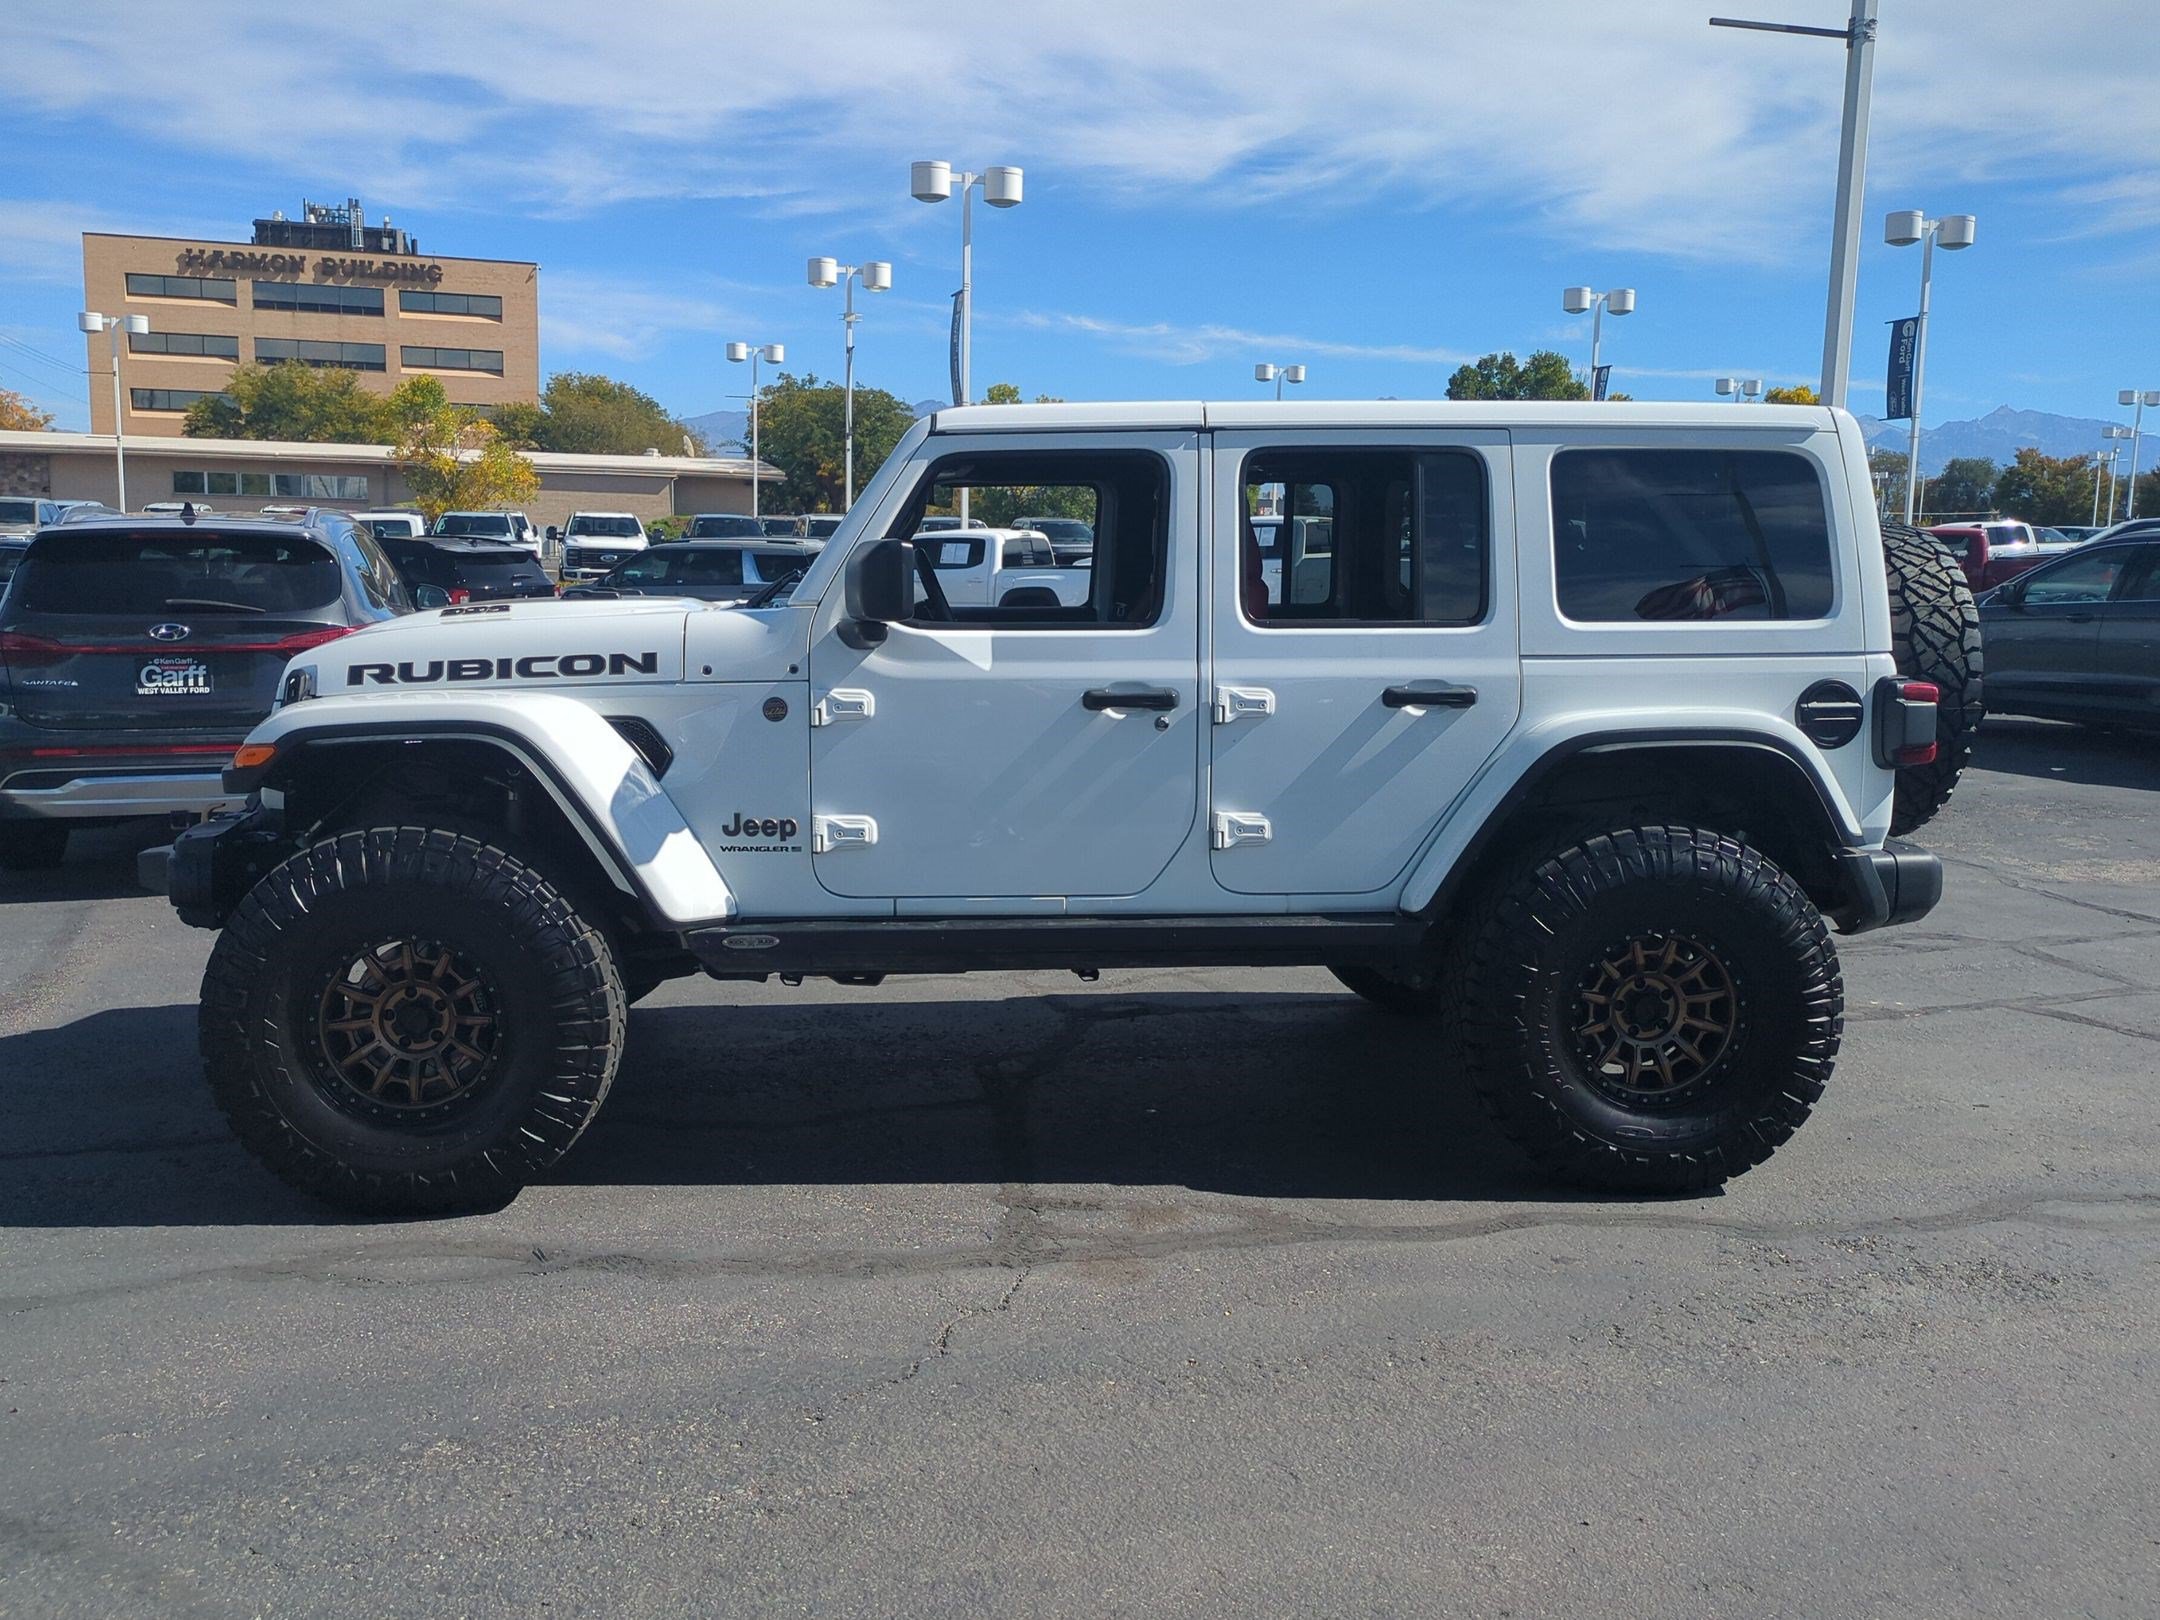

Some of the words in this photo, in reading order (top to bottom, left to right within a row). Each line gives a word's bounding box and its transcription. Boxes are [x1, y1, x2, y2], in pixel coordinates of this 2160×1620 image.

[185, 248, 306, 274] HARMON
[321, 256, 443, 283] BUILDING
[1899, 339, 1908, 364] Ford
[140, 665, 207, 688] Garff
[346, 651, 658, 686] RUBICON
[189, 686, 210, 694] FORD
[721, 812, 797, 841] Jeep
